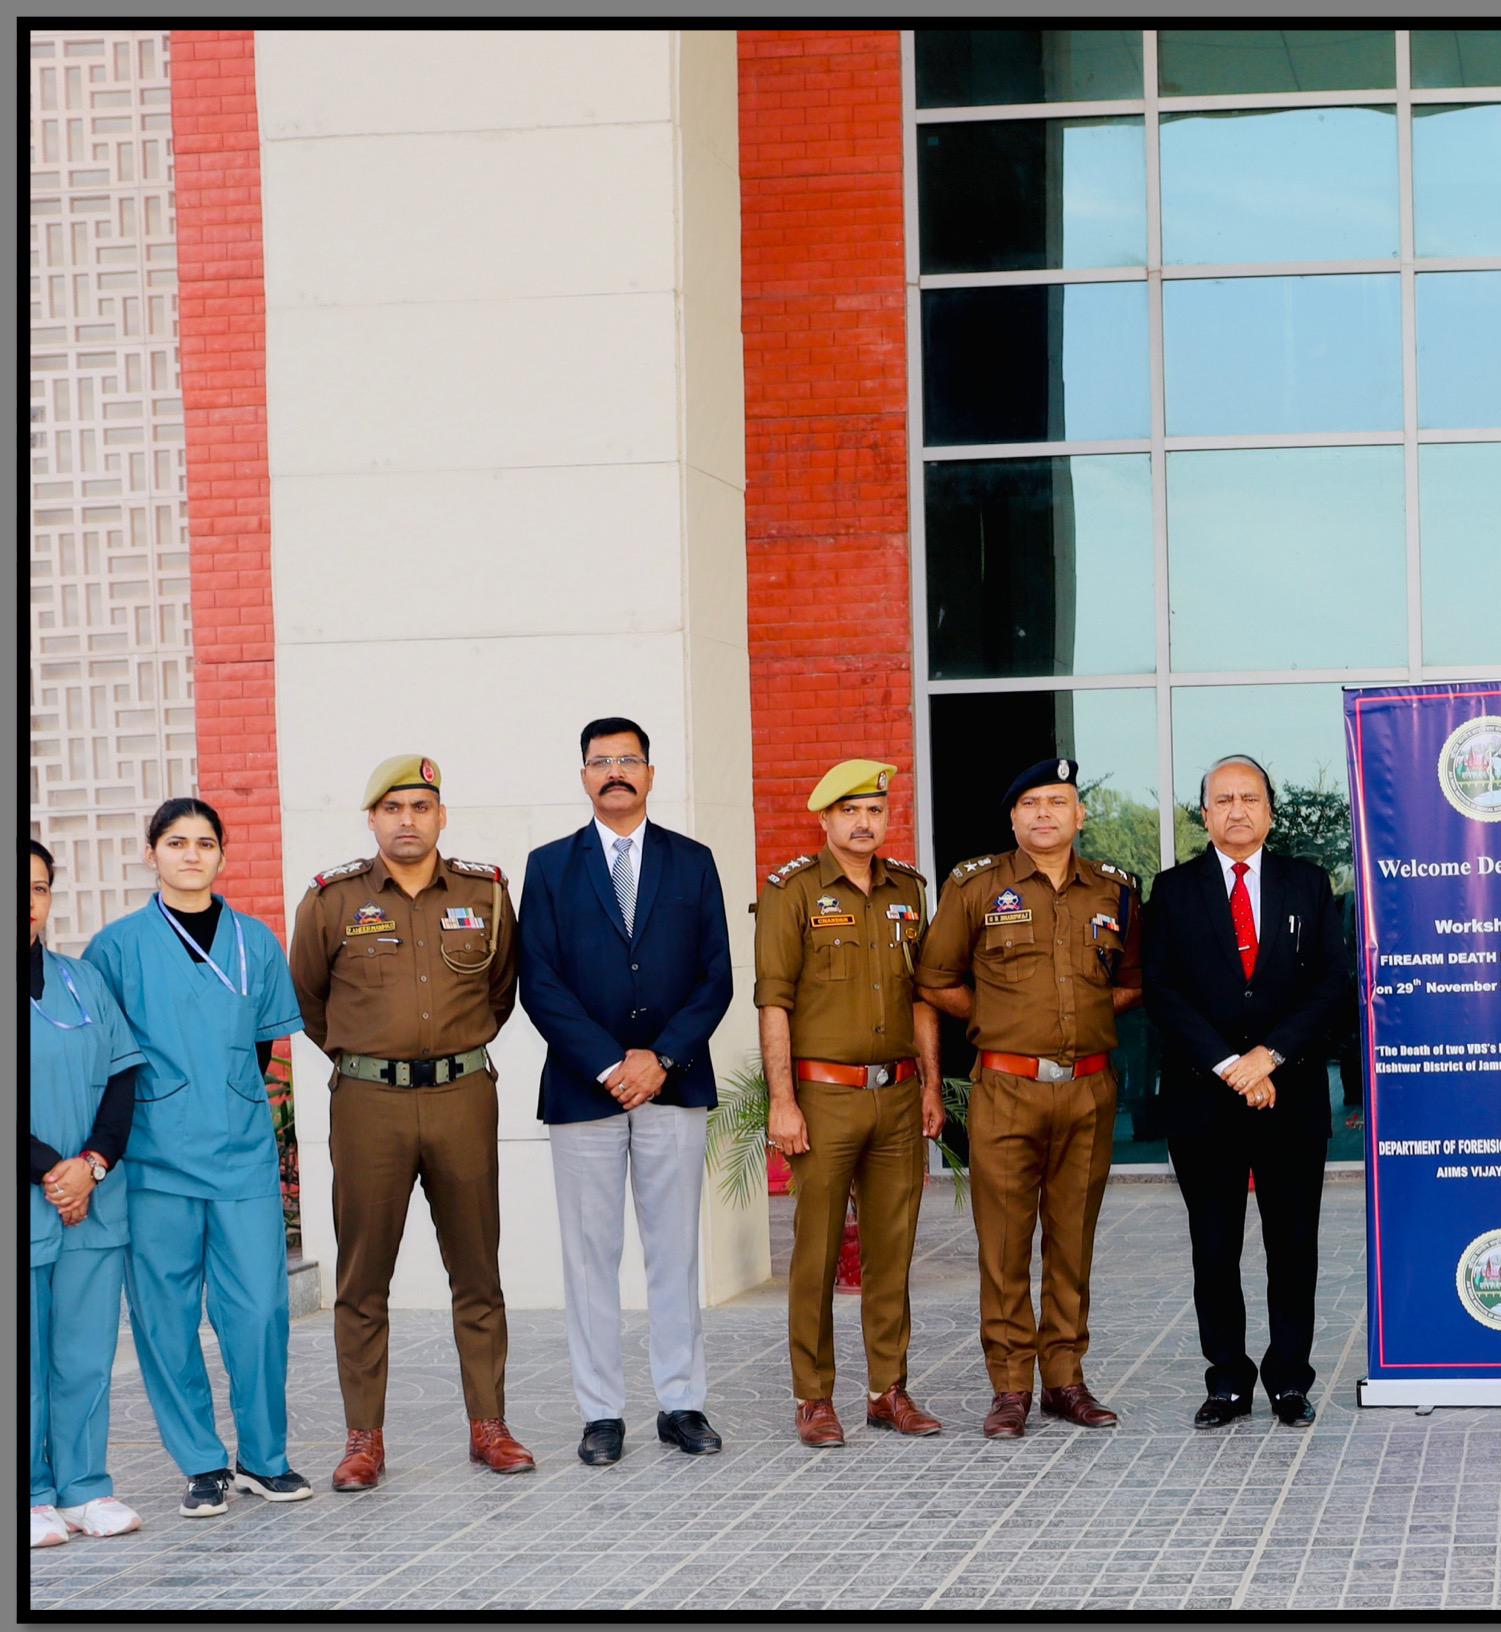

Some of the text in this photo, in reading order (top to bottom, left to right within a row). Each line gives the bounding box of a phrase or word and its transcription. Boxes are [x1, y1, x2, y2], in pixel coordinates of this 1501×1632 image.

[1377, 858, 1472, 878] Welcome
[1380, 953, 1444, 966] FIREARM
[1448, 951, 1497, 965] DEATH
[1376, 985, 1393, 995] on
[1396, 978, 1422, 994] 29th
[1426, 980, 1498, 994] November
[1400, 1044, 1431, 1056] Death
[1432, 1044, 1444, 1056] of
[1445, 1045, 1465, 1055] two
[1375, 1061, 1421, 1074] Kishtwar
[1423, 1061, 1464, 1073] District
[1465, 1060, 1476, 1071] of
[1378, 1140, 1441, 1156] DEPARTMENT
[1443, 1139, 1456, 1154] OF
[1436, 1166, 1468, 1178] AIIMS
